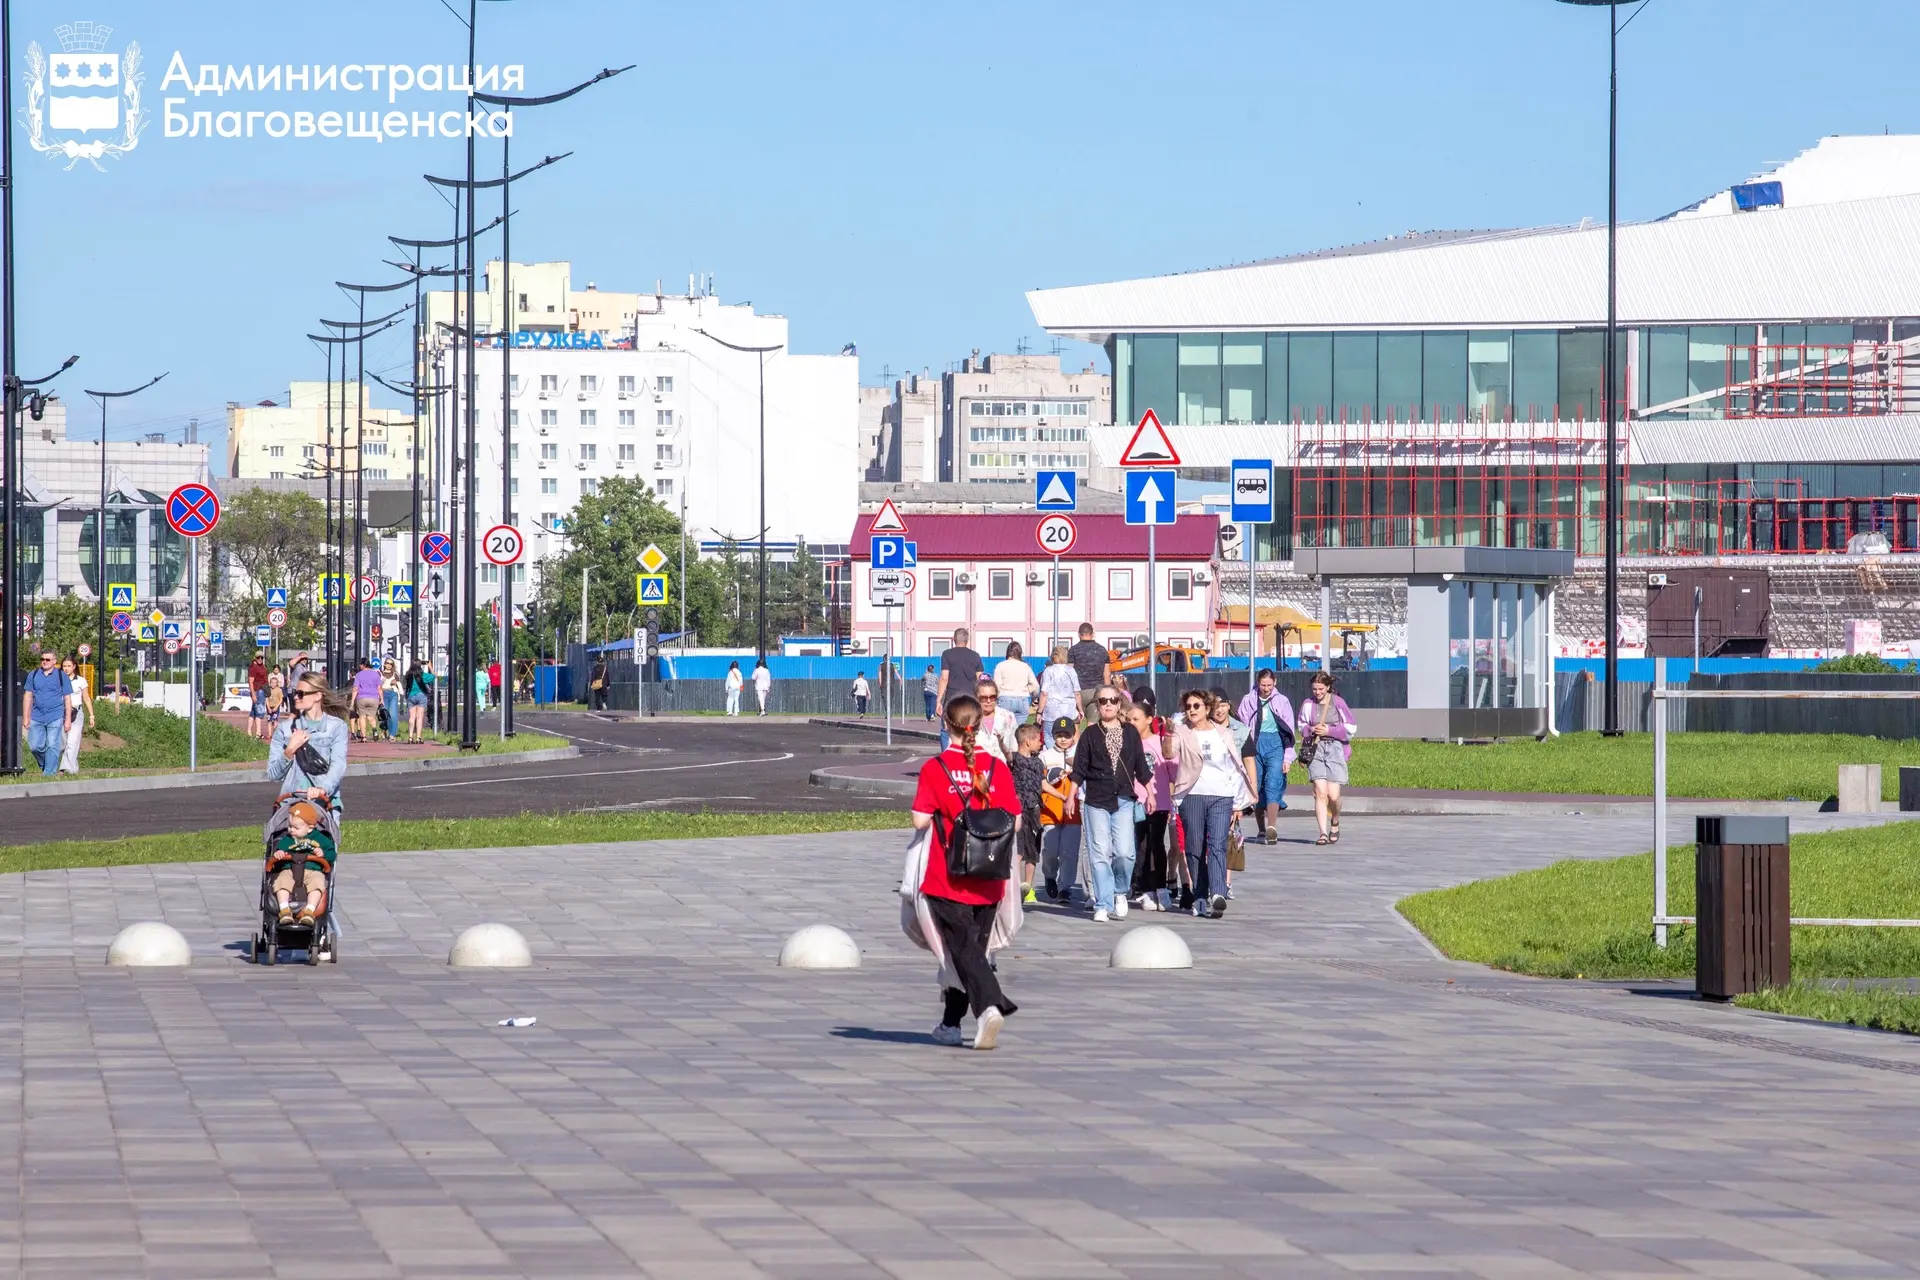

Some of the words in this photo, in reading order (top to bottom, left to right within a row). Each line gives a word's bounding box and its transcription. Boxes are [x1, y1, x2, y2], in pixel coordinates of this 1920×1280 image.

[1045, 526, 1069, 543] 20
[491, 536, 516, 554] 20
[272, 614, 283, 622] 20
[80, 645, 89, 653] 20
[167, 642, 177, 650] 20
[1060, 719, 1067, 728] S
